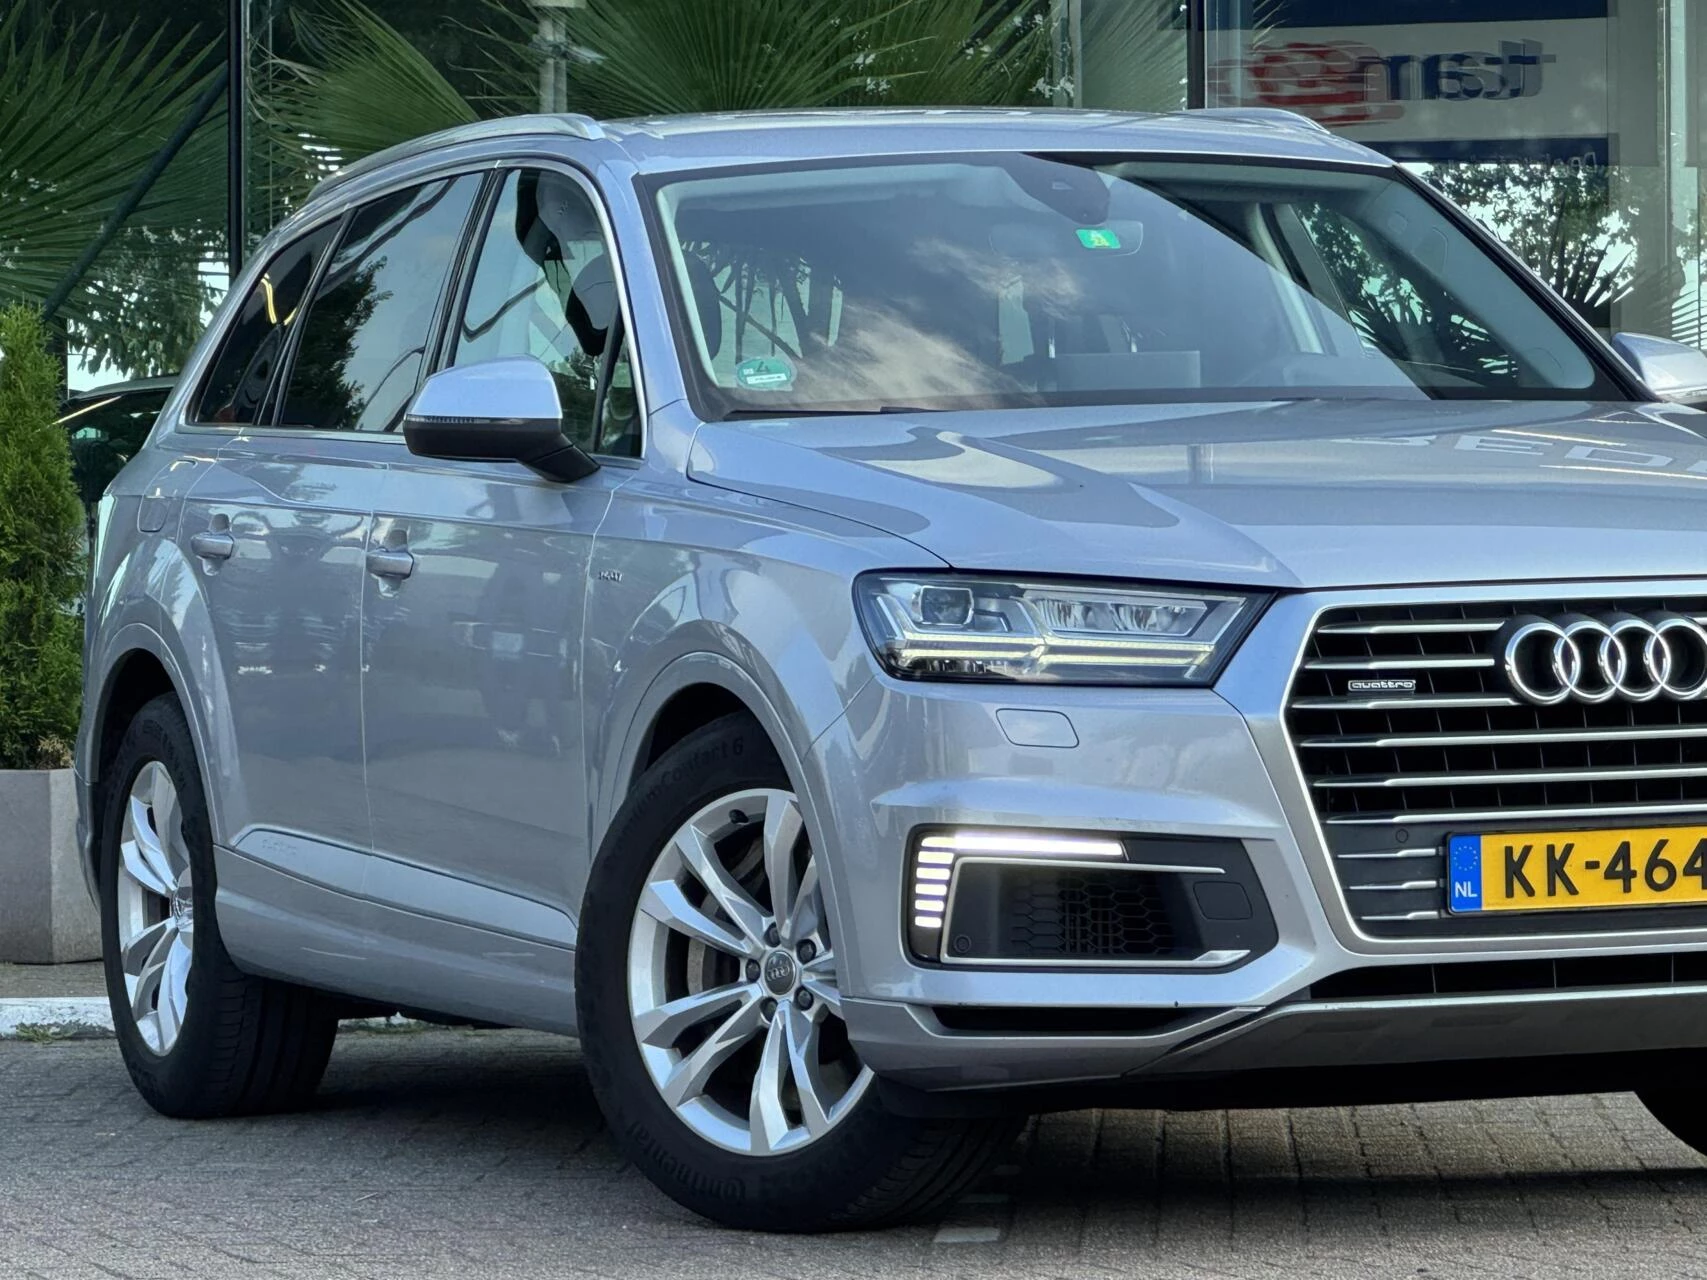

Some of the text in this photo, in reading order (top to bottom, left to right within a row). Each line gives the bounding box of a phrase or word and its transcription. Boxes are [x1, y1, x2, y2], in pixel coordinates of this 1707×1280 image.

[1351, 681, 1413, 689] quattro
[1504, 838, 1707, 899] KK-464
[1454, 880, 1478, 898] NL
[624, 1121, 746, 1203] Continental
